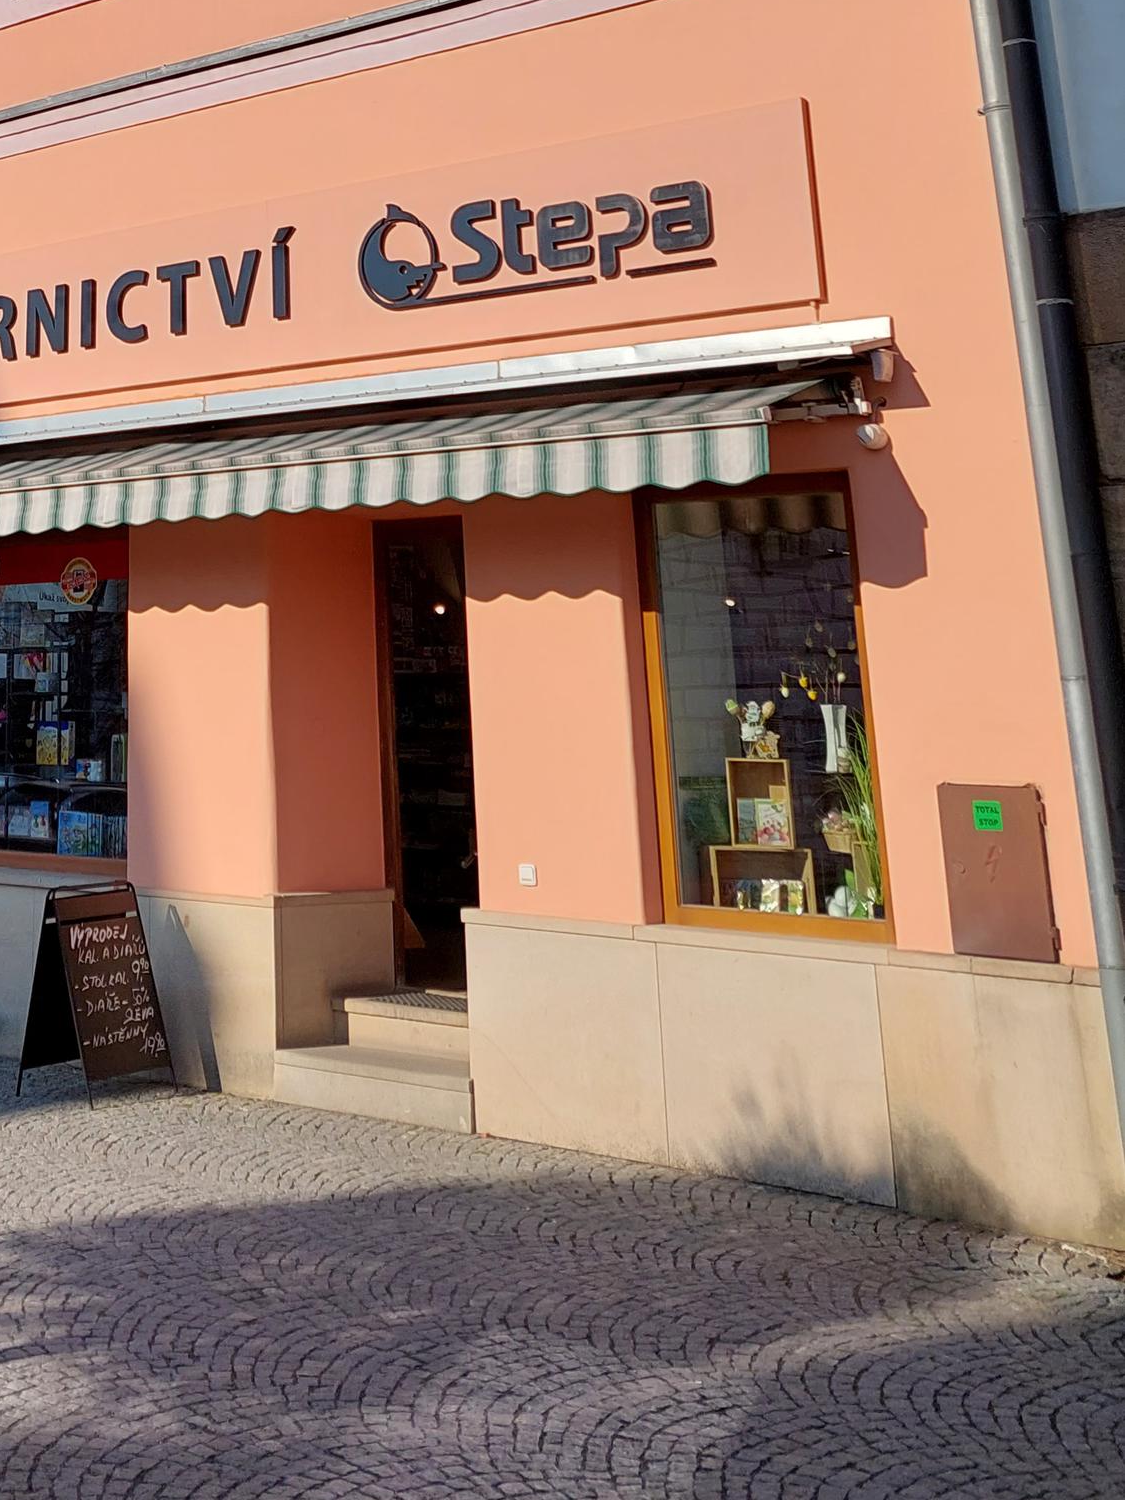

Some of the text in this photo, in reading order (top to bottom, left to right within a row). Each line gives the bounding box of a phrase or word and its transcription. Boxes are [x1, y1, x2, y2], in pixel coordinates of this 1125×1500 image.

[450, 179, 715, 280] Stepa
[975, 805, 1000, 814] TOTAL
[978, 818, 999, 827] STOP
[69, 923, 129, 950] VÝPRODEJ
[77, 946, 99, 964] KAL.
[102, 946, 110, 960] A
